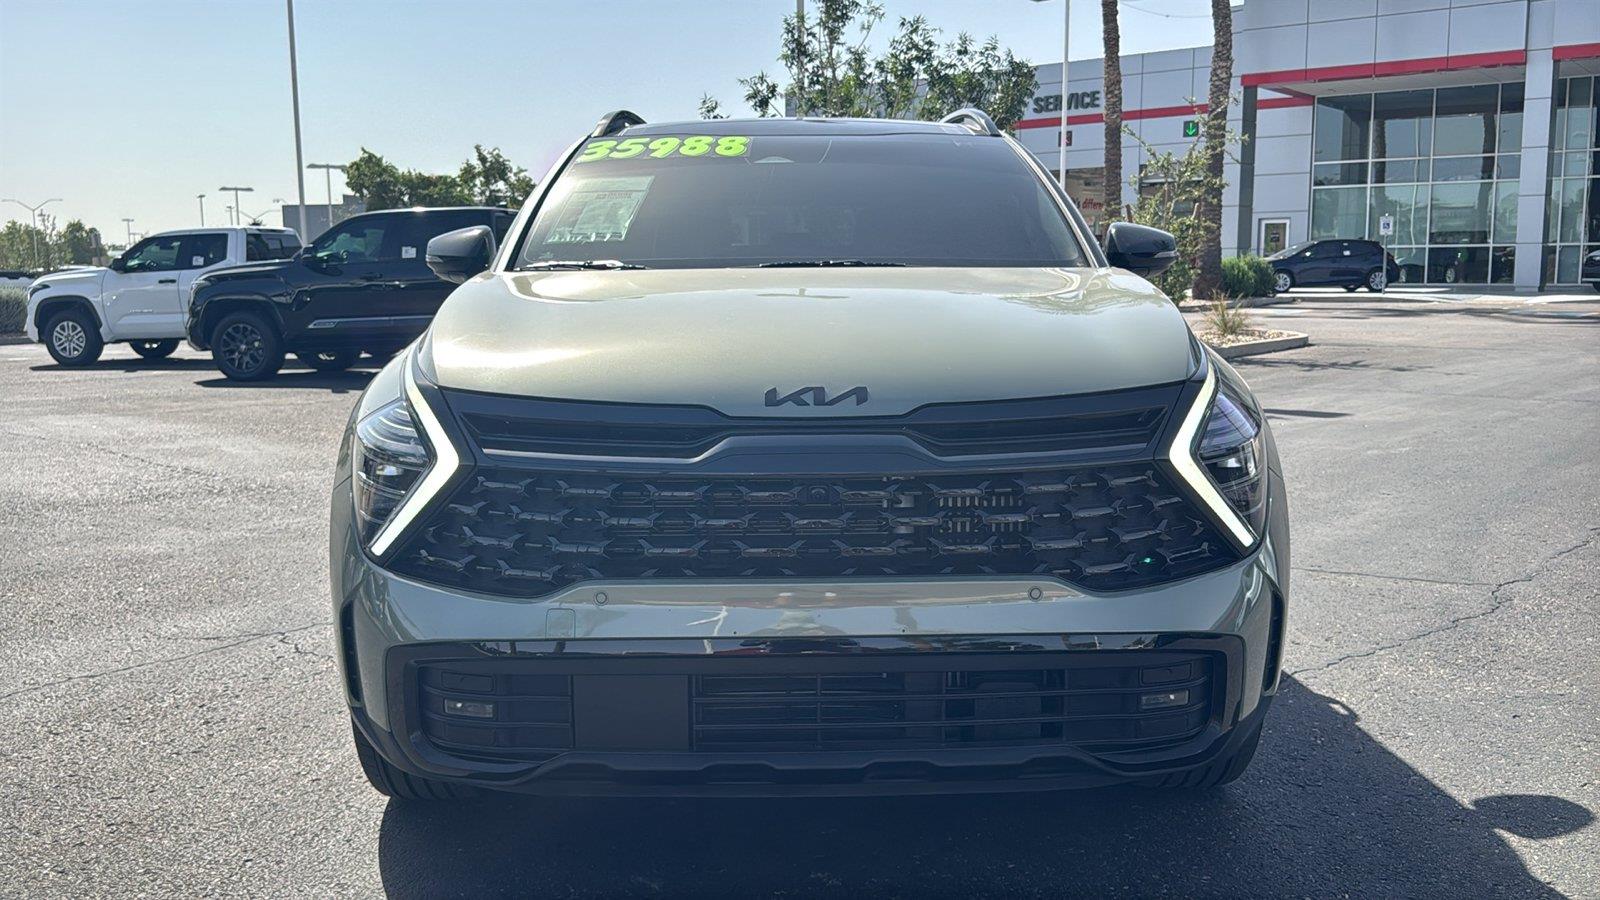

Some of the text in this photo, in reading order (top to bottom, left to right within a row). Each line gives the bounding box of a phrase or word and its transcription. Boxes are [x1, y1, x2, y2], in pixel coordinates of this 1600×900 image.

[1033, 90, 1100, 113] SERVICE
[575, 136, 750, 162] 35988
[765, 386, 868, 407] KIA
